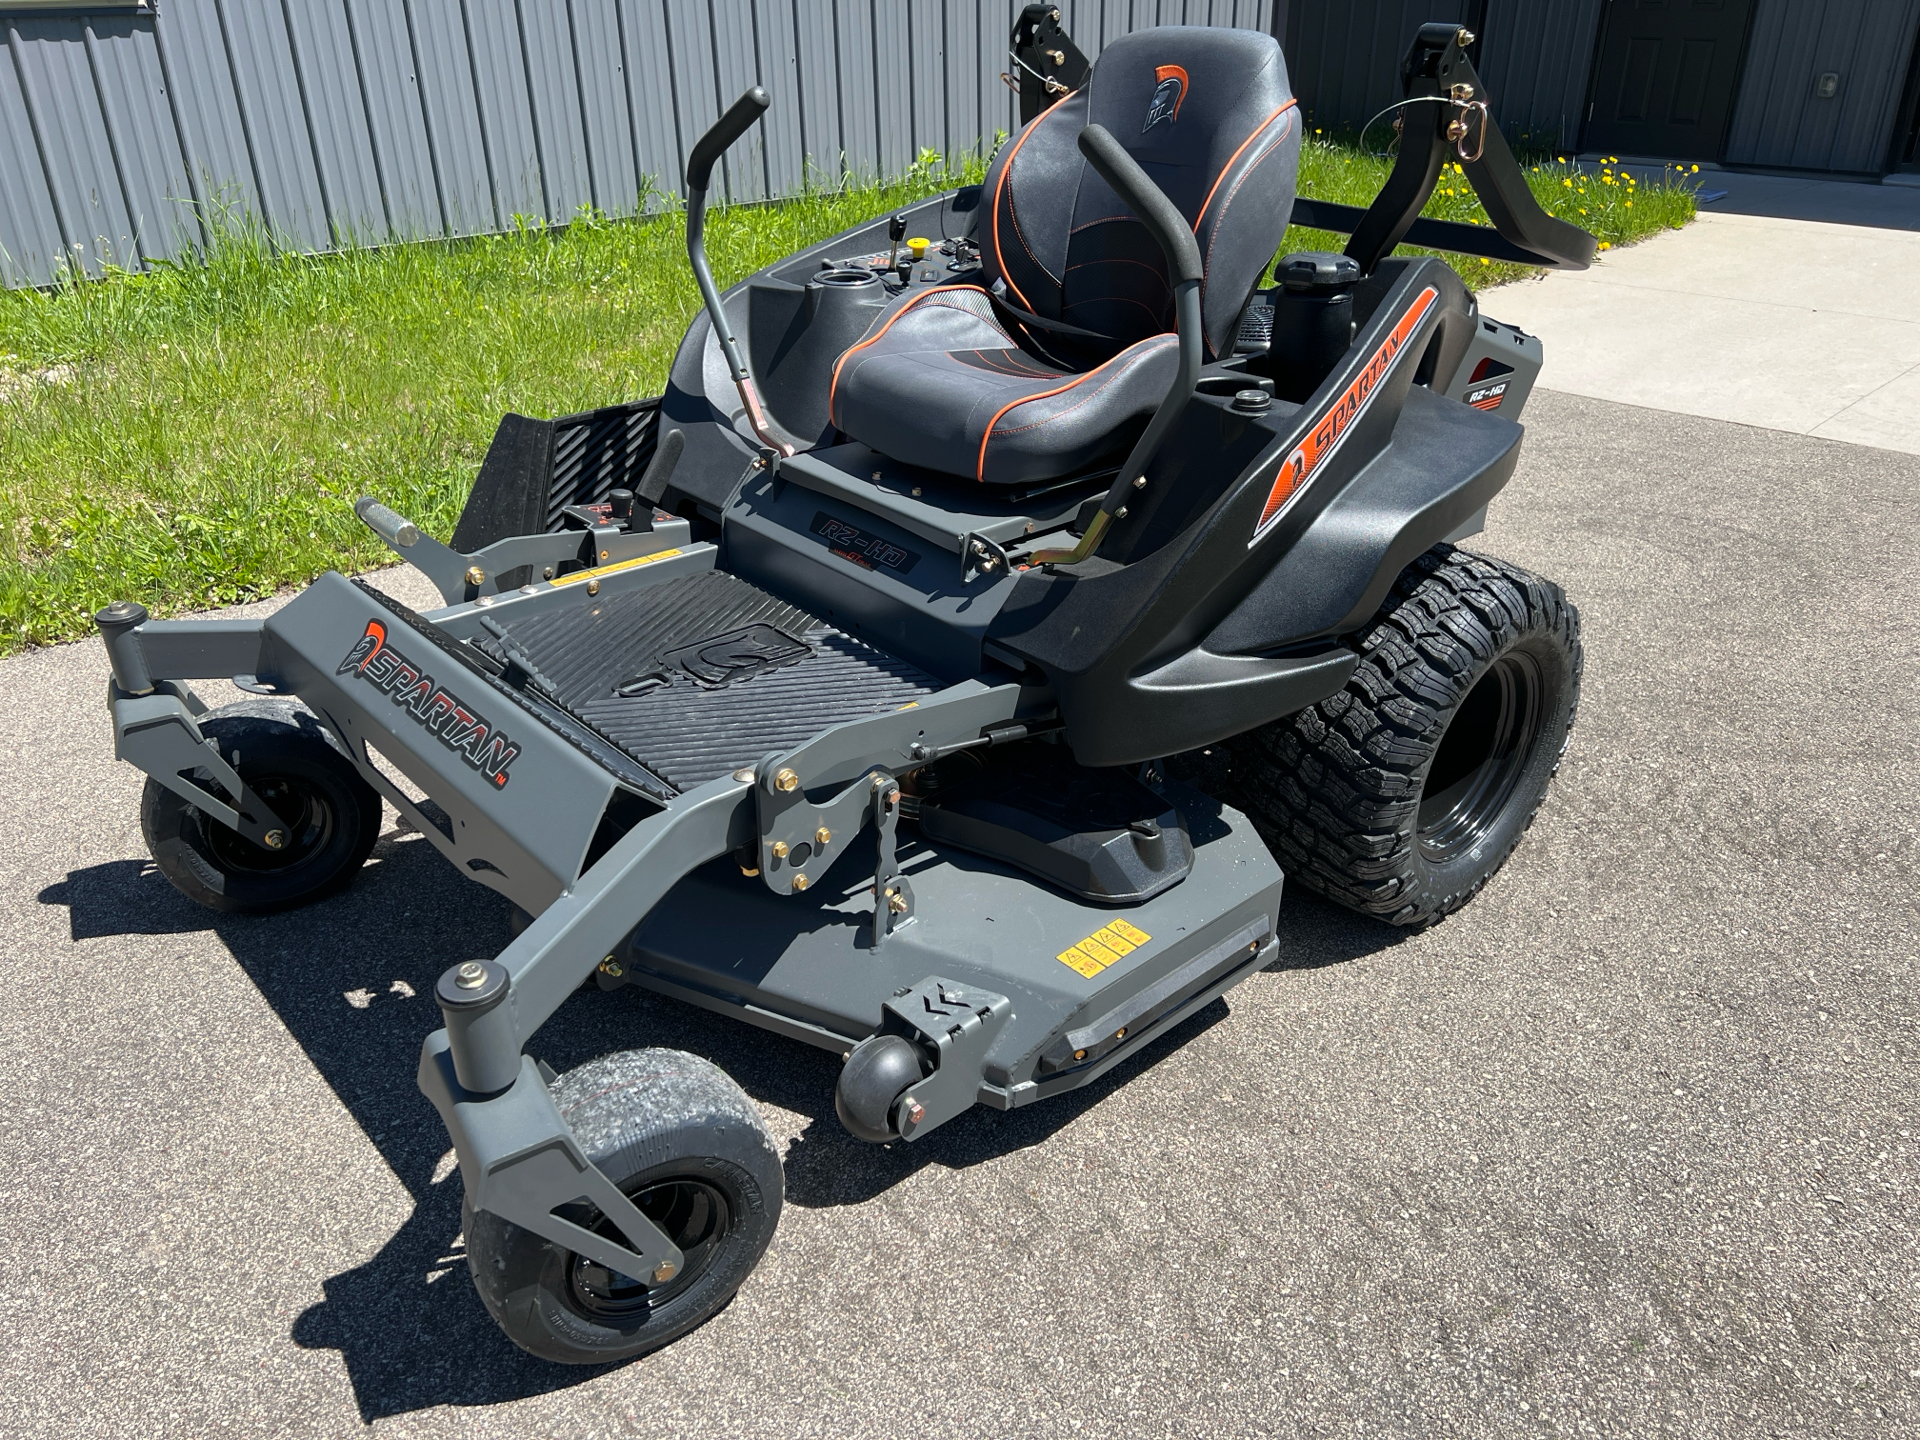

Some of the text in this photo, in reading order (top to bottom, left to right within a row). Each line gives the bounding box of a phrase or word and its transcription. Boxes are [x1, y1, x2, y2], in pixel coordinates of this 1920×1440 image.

[1316, 331, 1400, 458] SPARTAN
[1469, 383, 1506, 403] RZ-HD
[819, 519, 908, 568] RZ-HD
[364, 648, 517, 777] SPARTAN
